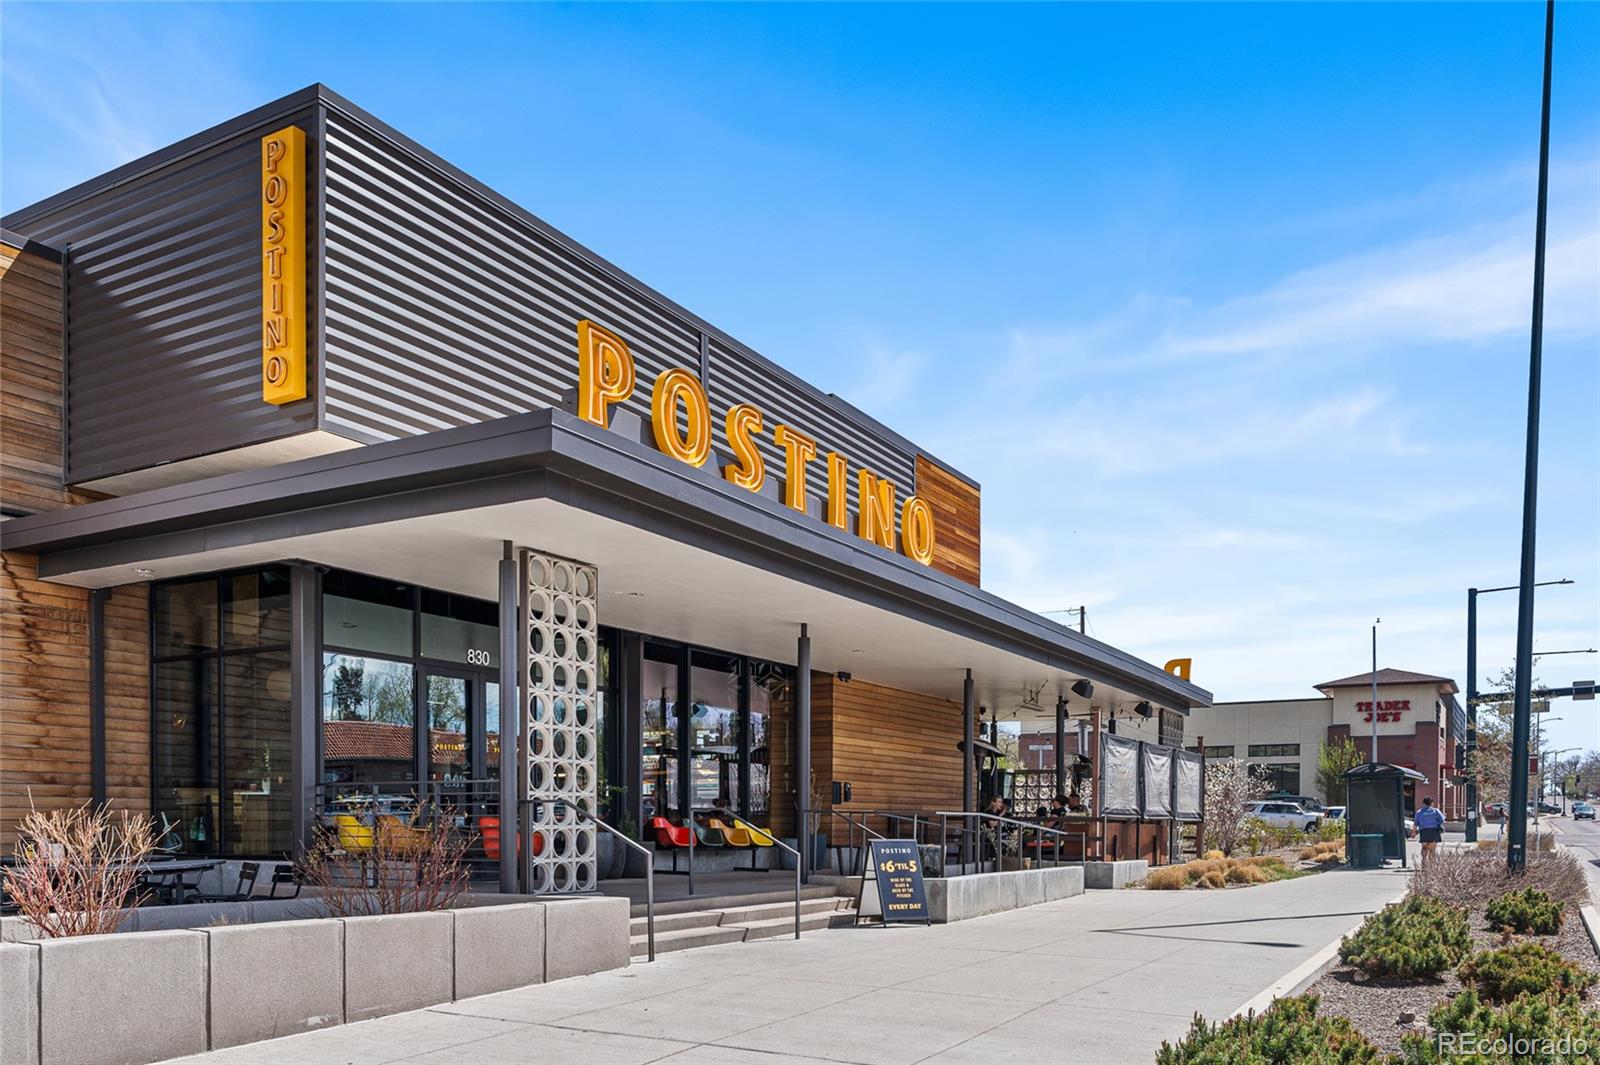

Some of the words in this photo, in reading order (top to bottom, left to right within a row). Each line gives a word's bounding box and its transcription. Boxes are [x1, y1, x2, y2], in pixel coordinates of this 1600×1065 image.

[264, 138, 288, 387] POSTINO
[577, 319, 936, 566] POSTINO
[467, 648, 490, 666] 830
[1356, 700, 1411, 712] TRADER
[1363, 712, 1402, 722] JOE'S
[909, 860, 917, 873] 5
